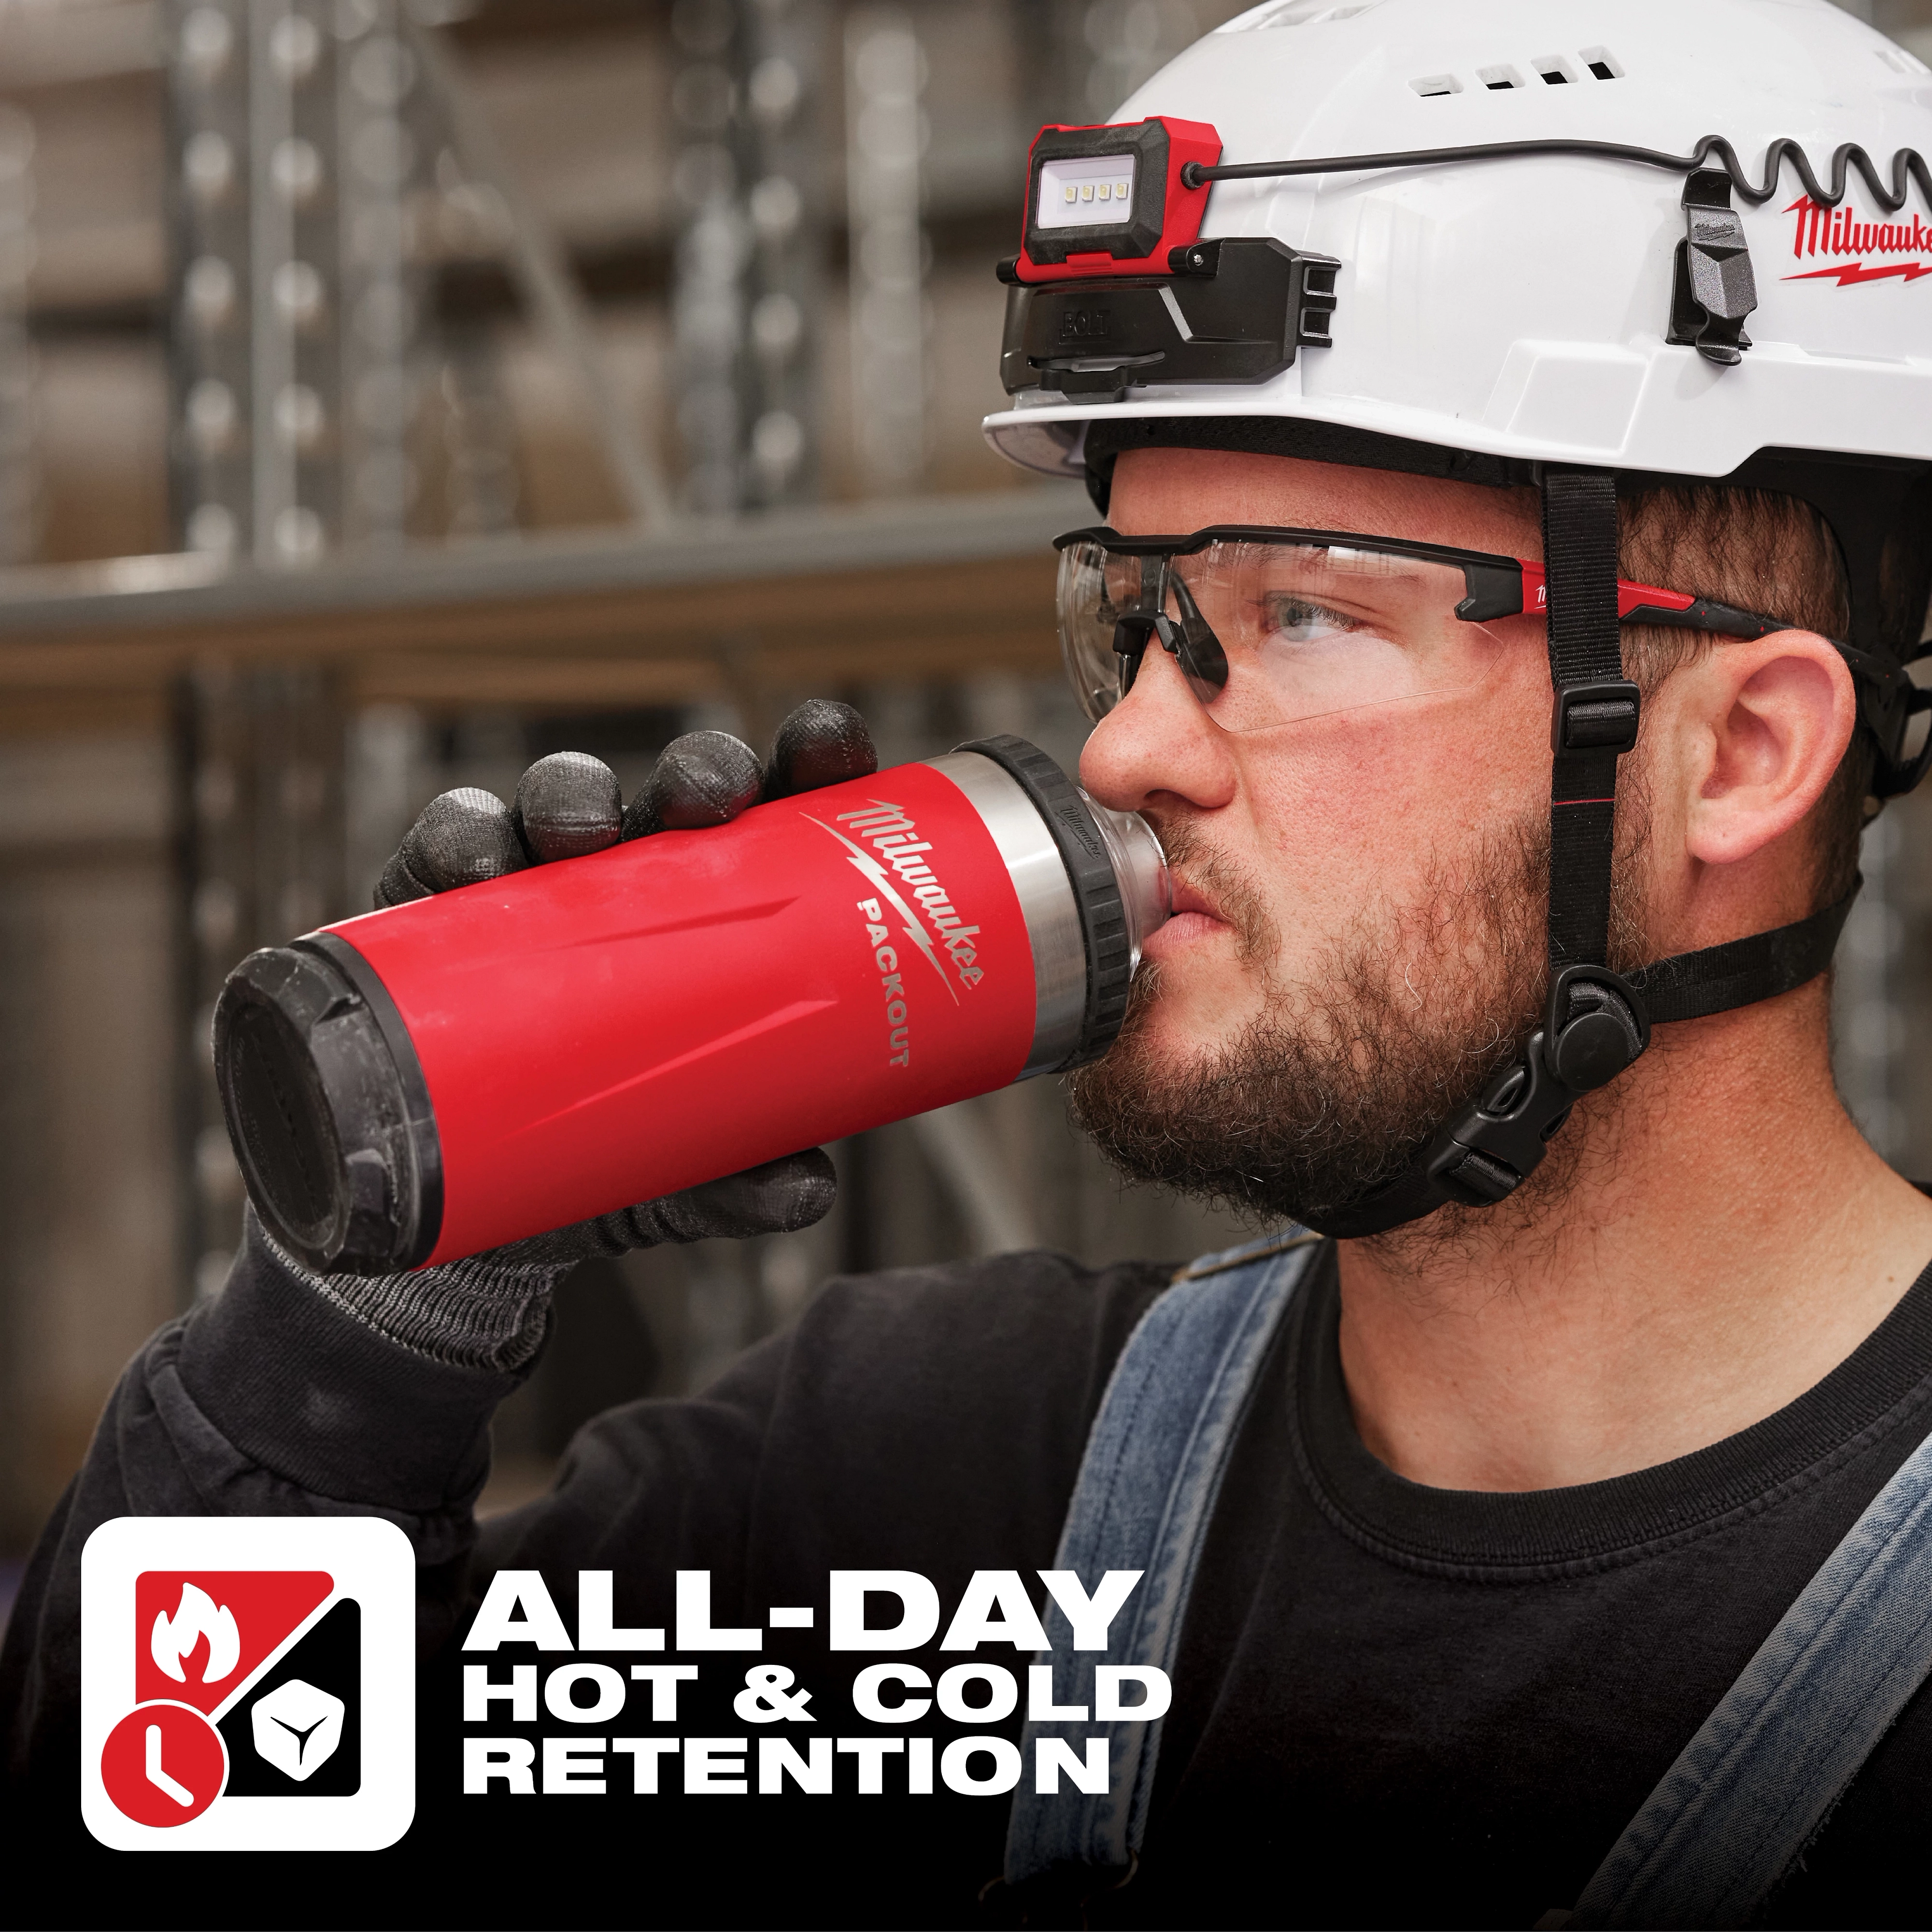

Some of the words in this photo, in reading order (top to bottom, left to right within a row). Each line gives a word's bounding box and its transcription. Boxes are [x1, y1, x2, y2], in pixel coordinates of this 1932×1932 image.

[1062, 310, 1110, 337] BOLT
[836, 798, 984, 990] Milwaukee
[856, 897, 909, 1067] PACKOUT
